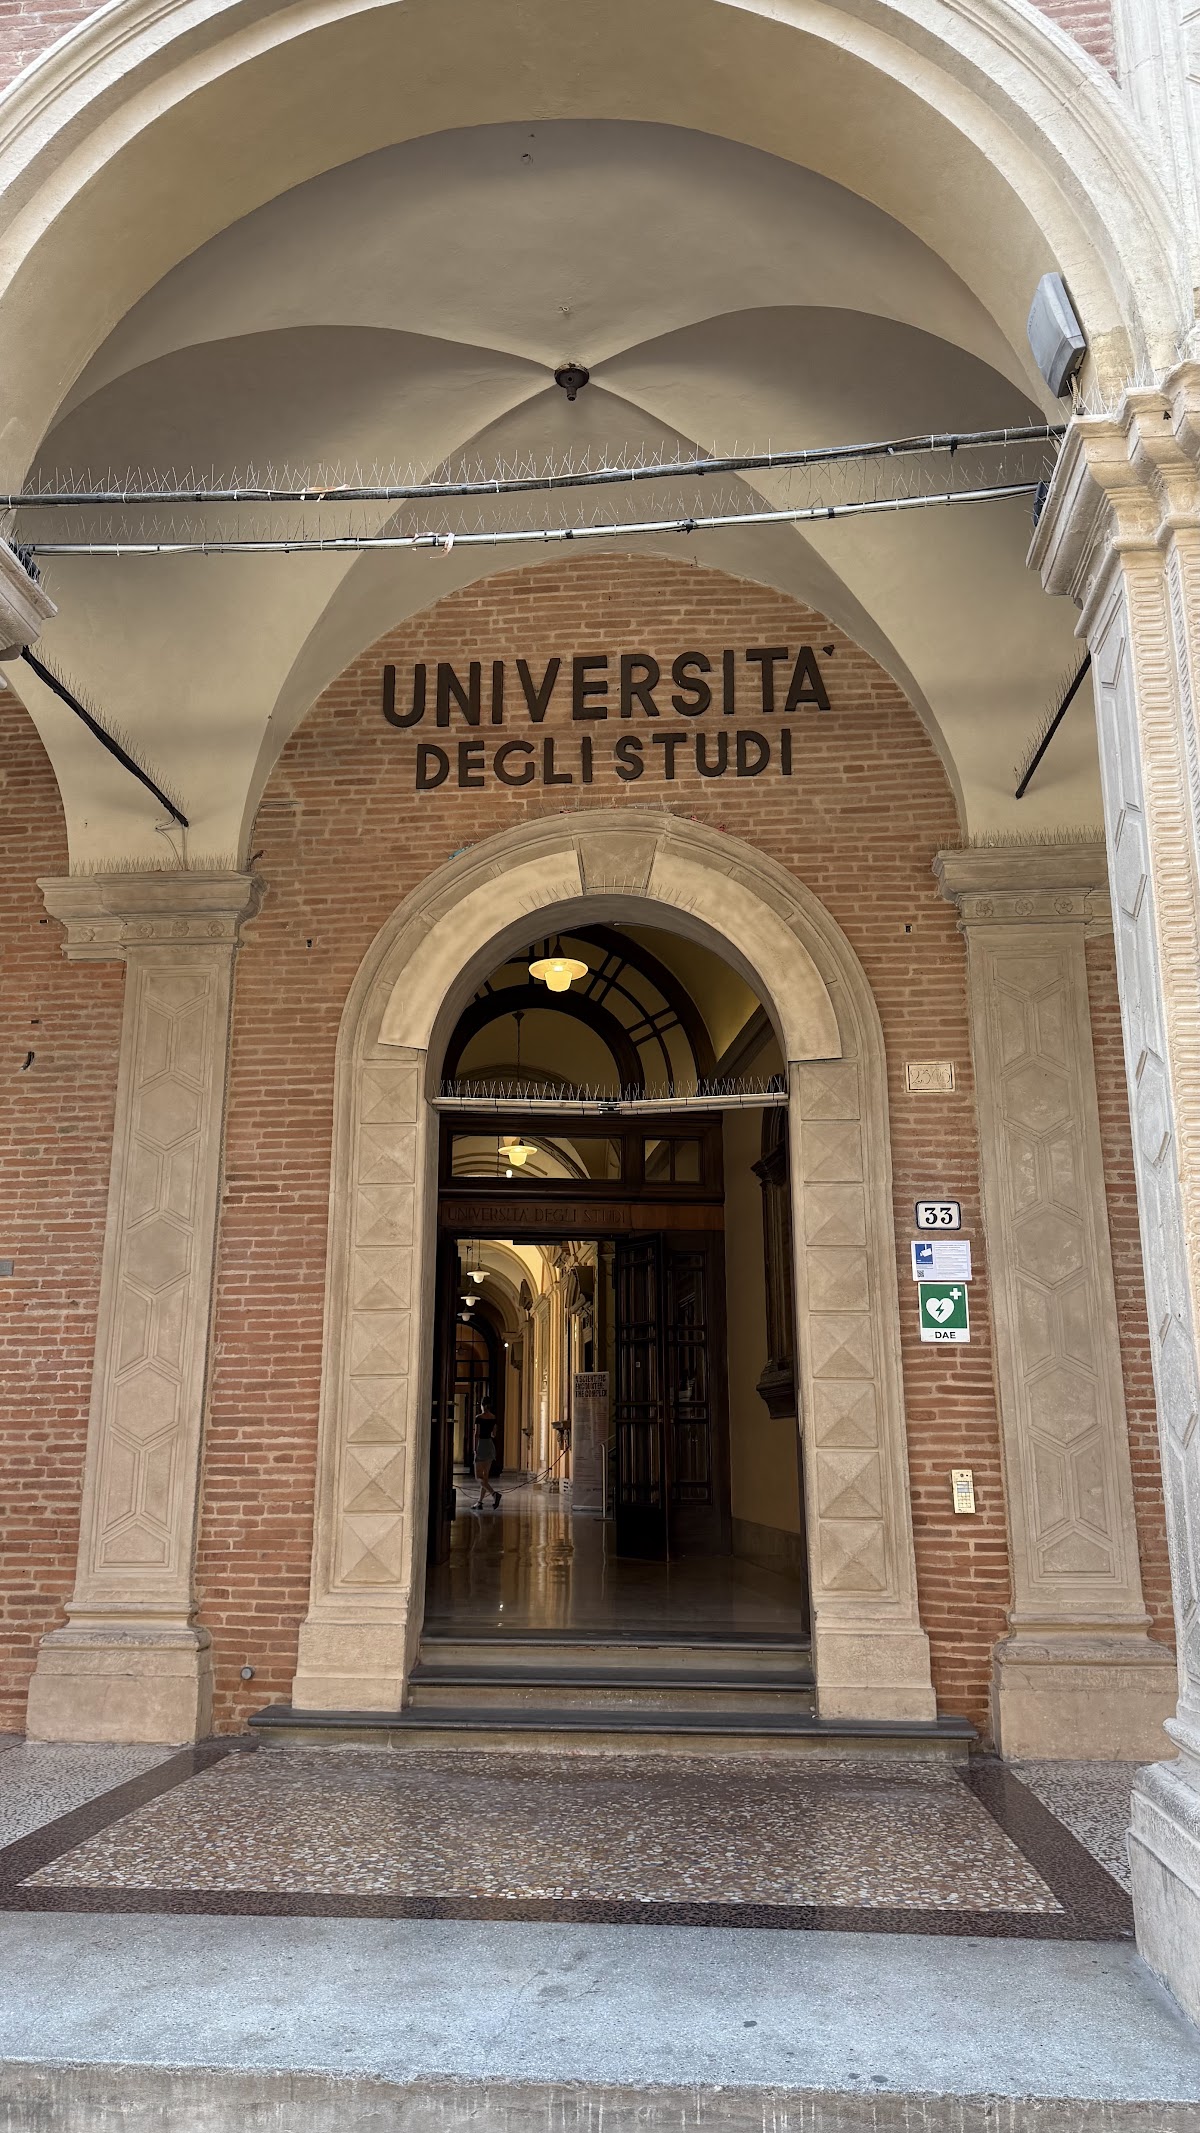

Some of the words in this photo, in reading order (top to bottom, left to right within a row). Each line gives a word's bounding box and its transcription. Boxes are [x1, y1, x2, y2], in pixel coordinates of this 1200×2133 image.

[415, 736, 593, 789] DEGLI
[615, 728, 793, 780] STUDI
[534, 1207, 577, 1223] DEGLI
[583, 1208, 626, 1224] STUDI
[924, 1207, 953, 1225] 33
[934, 1331, 957, 1340] DAE
[575, 1390, 584, 1398] THE
